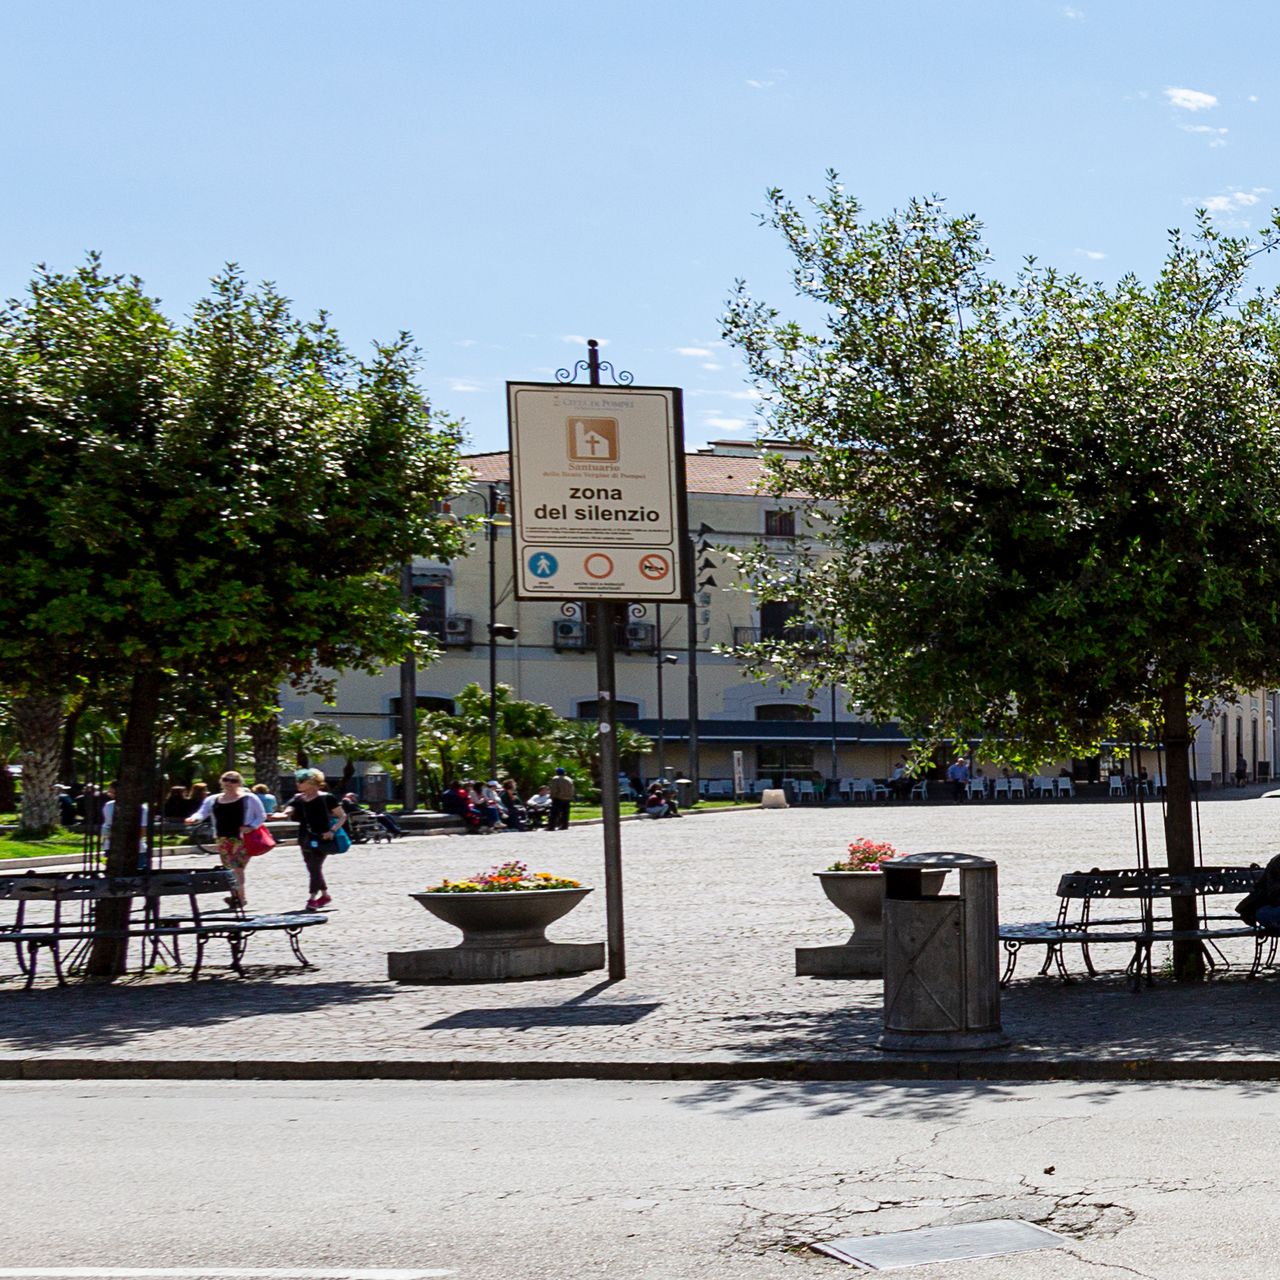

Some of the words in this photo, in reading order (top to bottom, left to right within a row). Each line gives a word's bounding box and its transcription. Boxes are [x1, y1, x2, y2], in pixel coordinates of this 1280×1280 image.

[568, 463, 620, 472] Santuario
[569, 487, 623, 500] zona
[534, 503, 567, 520] del
[575, 505, 660, 522] silenzio
